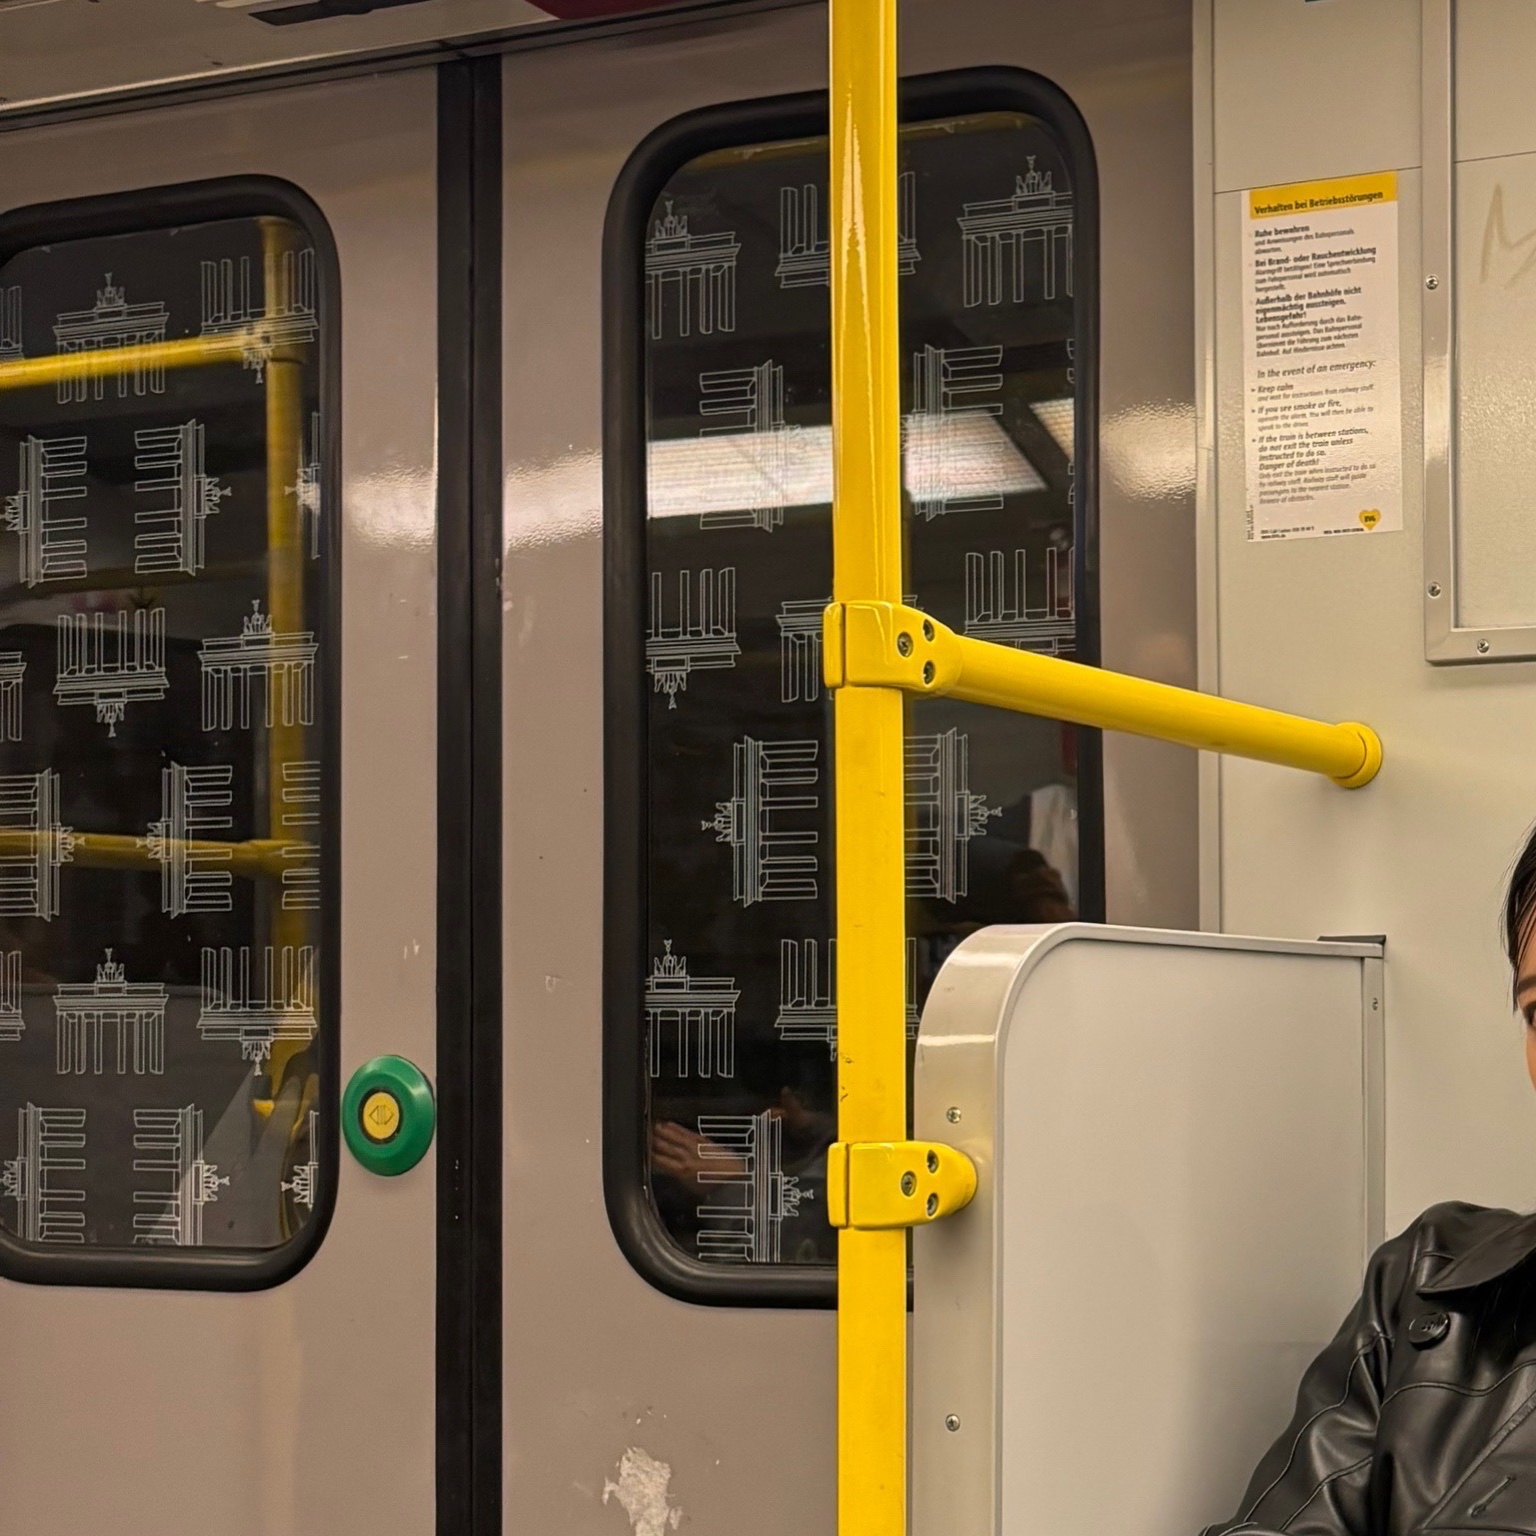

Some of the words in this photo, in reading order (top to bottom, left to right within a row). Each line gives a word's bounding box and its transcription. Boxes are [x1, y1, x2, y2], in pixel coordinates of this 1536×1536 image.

[1254, 204, 1293, 214] Verhalten
[1295, 201, 1307, 209] bei
[1309, 192, 1383, 208] Betriebsstörungen
[1268, 256, 1291, 266] Brand-
[1256, 294, 1292, 305] Außerhalb
[1308, 289, 1342, 299] Bahnhöfe
[1344, 287, 1361, 295] nicht
[1258, 370, 1265, 378] In
[1268, 369, 1280, 377] the
[1282, 367, 1305, 376] event
[1306, 365, 1316, 373] of
[1330, 361, 1376, 371] emergency:
[1306, 431, 1336, 439] between
[1331, 438, 1353, 446] unless
[1286, 460, 1295, 468] of
